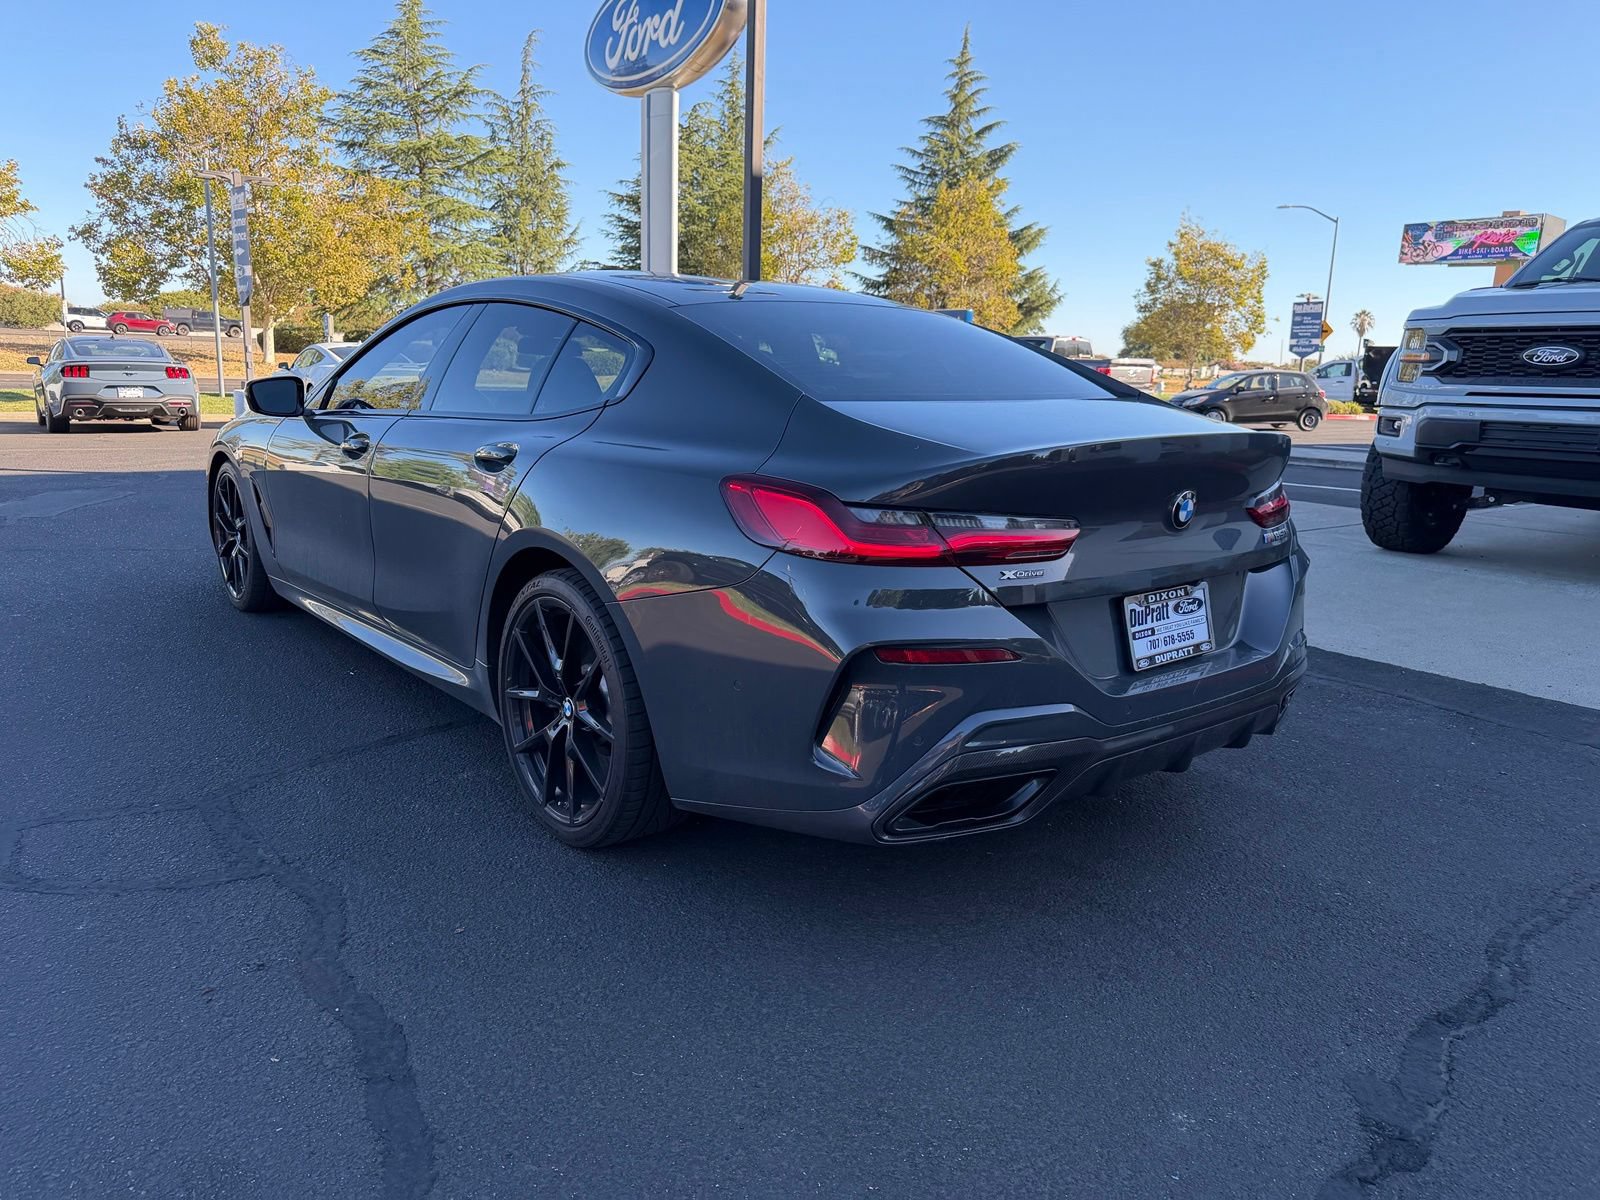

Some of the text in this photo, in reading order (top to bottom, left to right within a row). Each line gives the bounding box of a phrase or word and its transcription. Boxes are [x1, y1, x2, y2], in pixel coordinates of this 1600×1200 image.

[605, 0, 685, 70] Ford
[1490, 246, 1514, 254] BOARD
[1533, 348, 1567, 362] Ford
[1148, 588, 1185, 603] DIXON
[1178, 598, 1199, 614] Ford
[1129, 602, 1170, 628] DuPratt
[585, 615, 610, 664] Continental
[1135, 629, 1152, 639] DIXON
[1146, 630, 1195, 651] (707) 678-5555
[1155, 646, 1194, 663] DUPRATT
